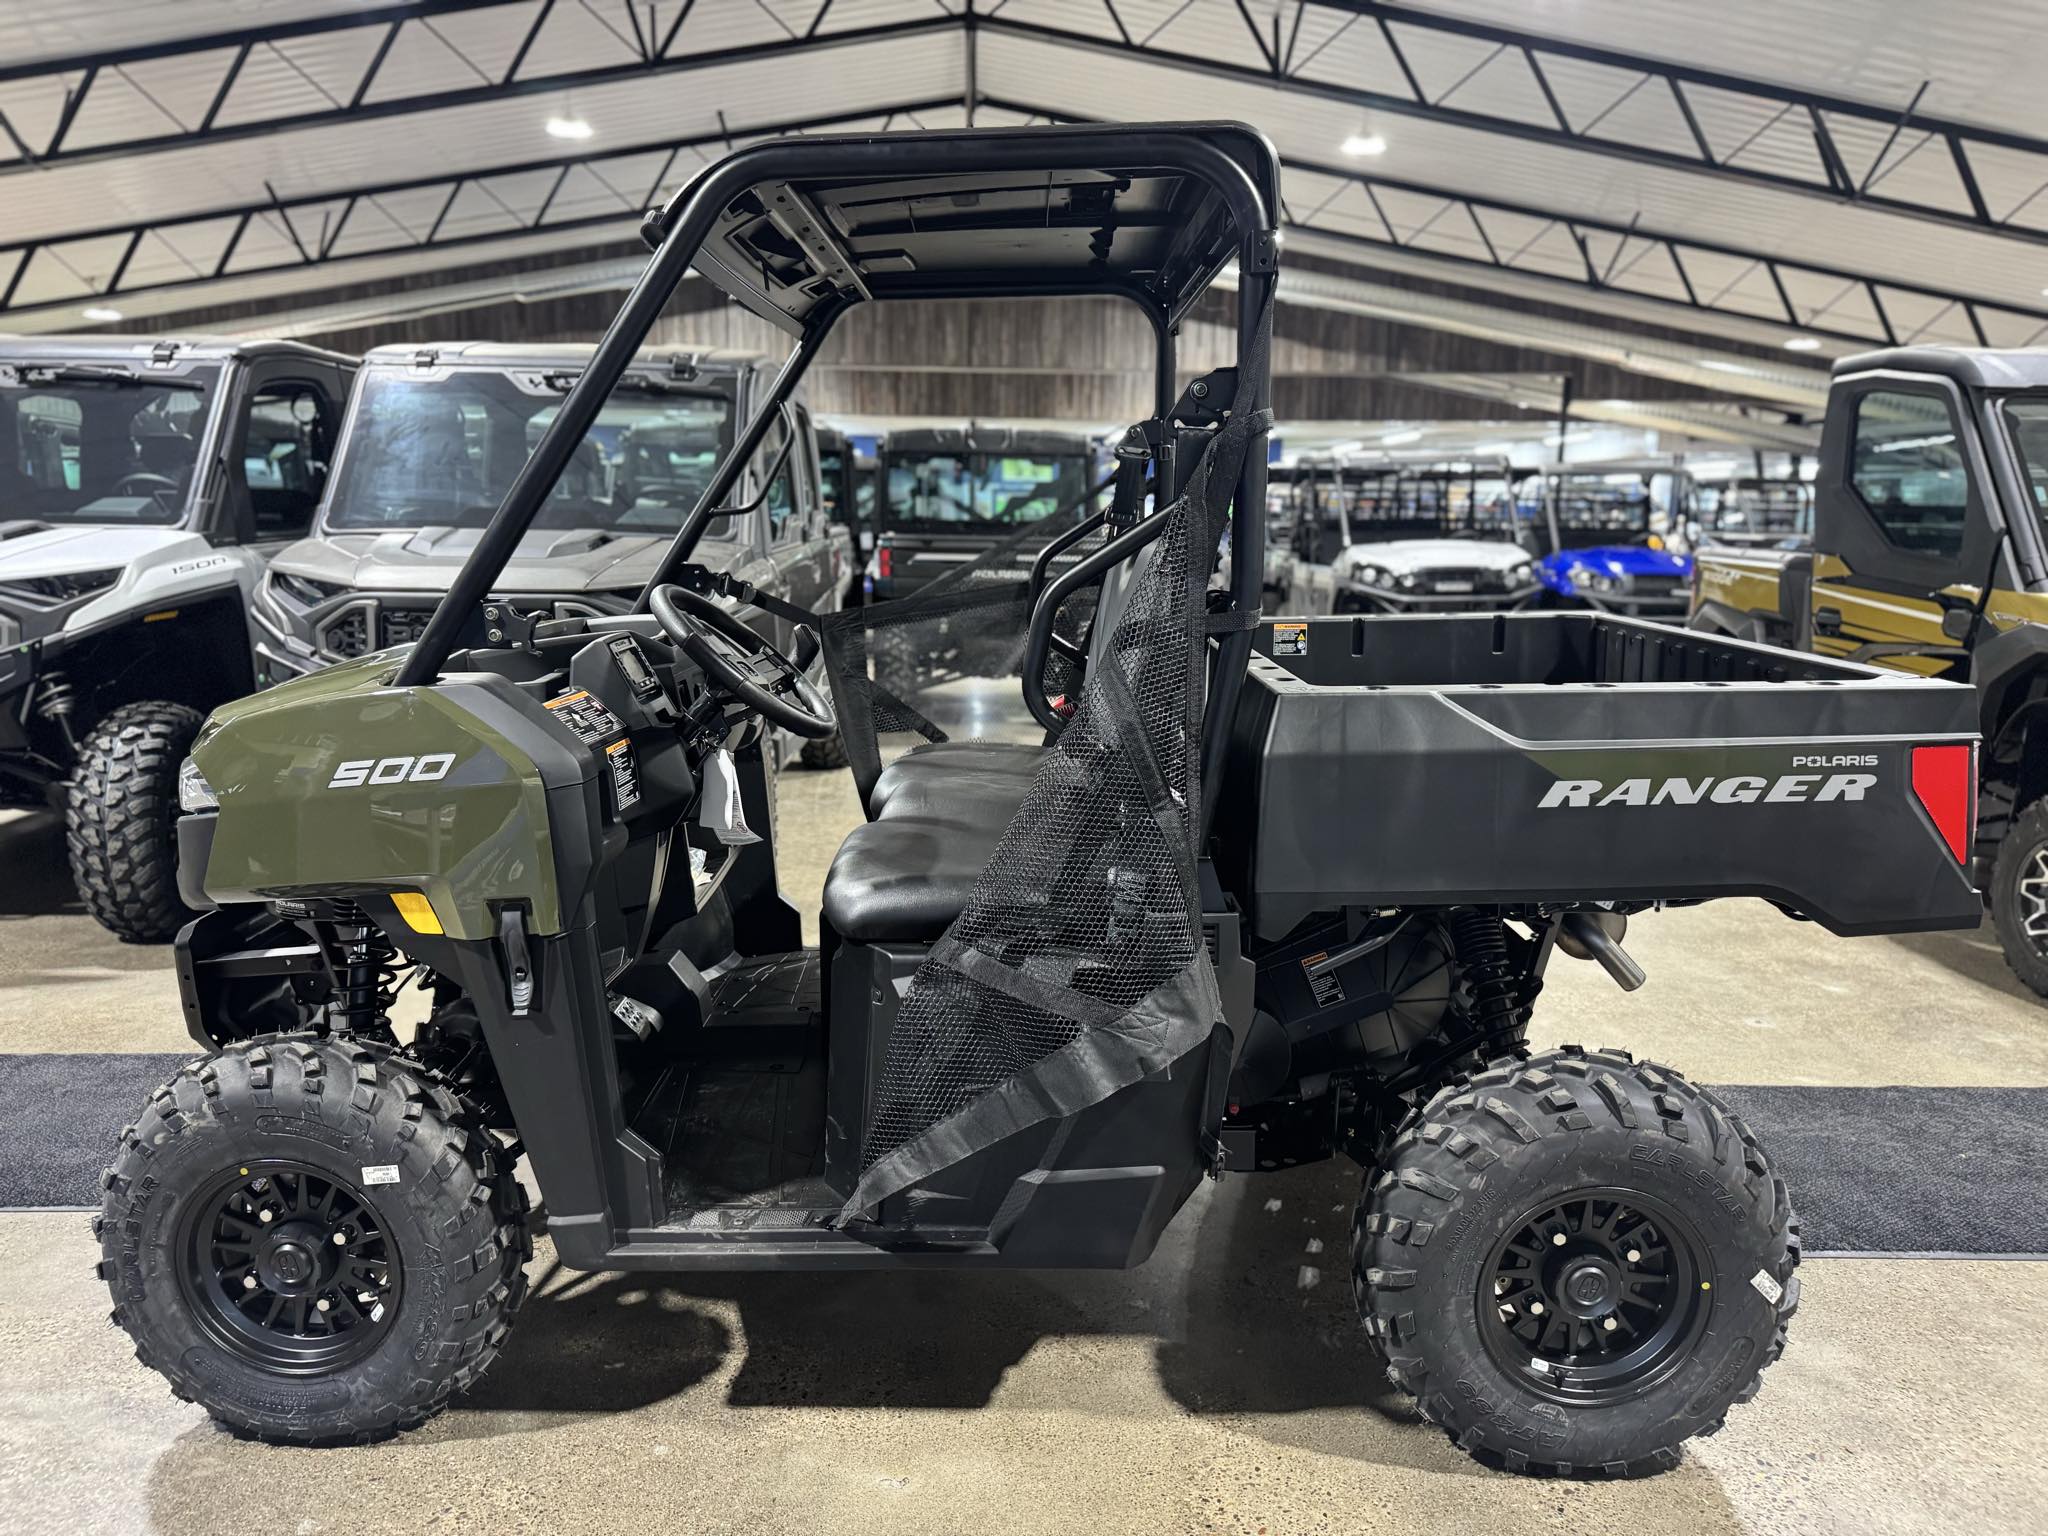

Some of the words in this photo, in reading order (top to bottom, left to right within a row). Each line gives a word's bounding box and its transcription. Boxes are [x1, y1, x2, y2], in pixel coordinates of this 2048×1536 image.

[327, 753, 457, 789] 500
[1792, 755, 1879, 768] POLARIS
[1536, 774, 1878, 808] RANGER
[1630, 1144, 1747, 1222] CARLSTAR
